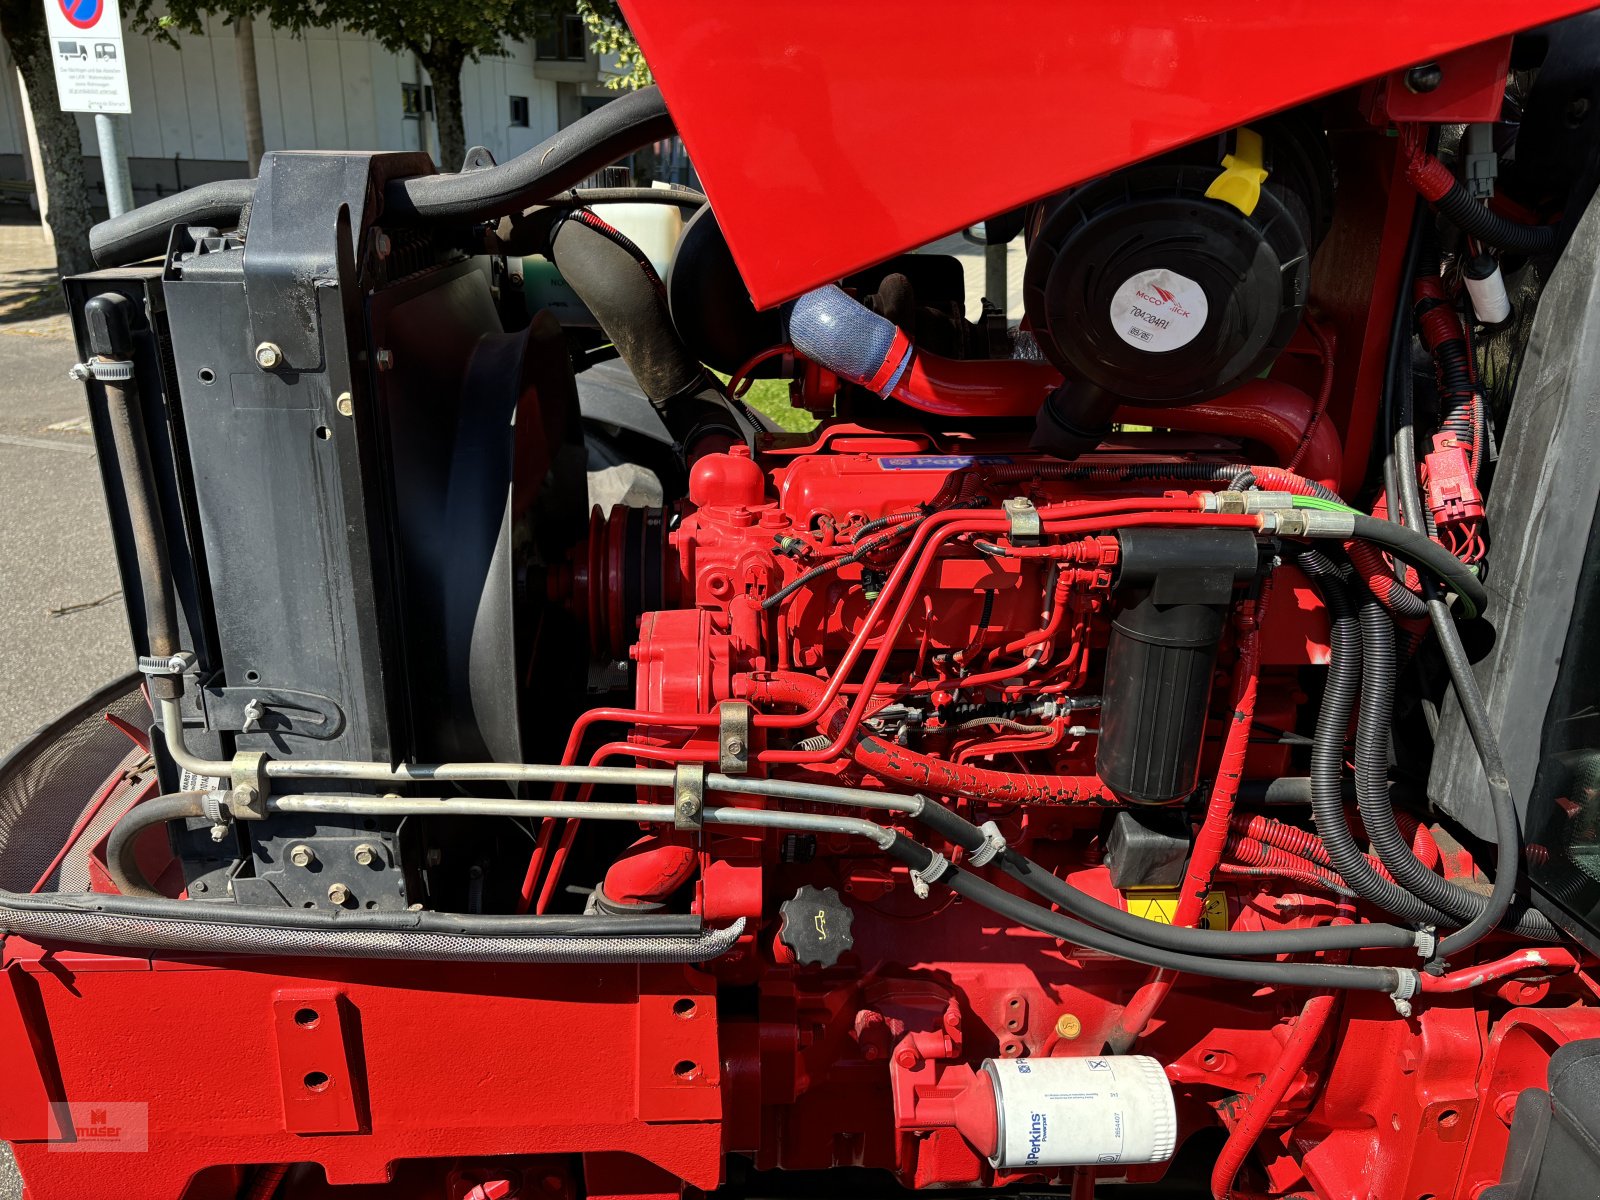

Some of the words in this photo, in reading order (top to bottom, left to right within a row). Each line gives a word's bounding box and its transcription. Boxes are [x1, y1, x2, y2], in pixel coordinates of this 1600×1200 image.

[1136, 290, 1190, 318] McCOICK
[915, 457, 1008, 466] Perkns
[1027, 1112, 1041, 1160] Perkins
